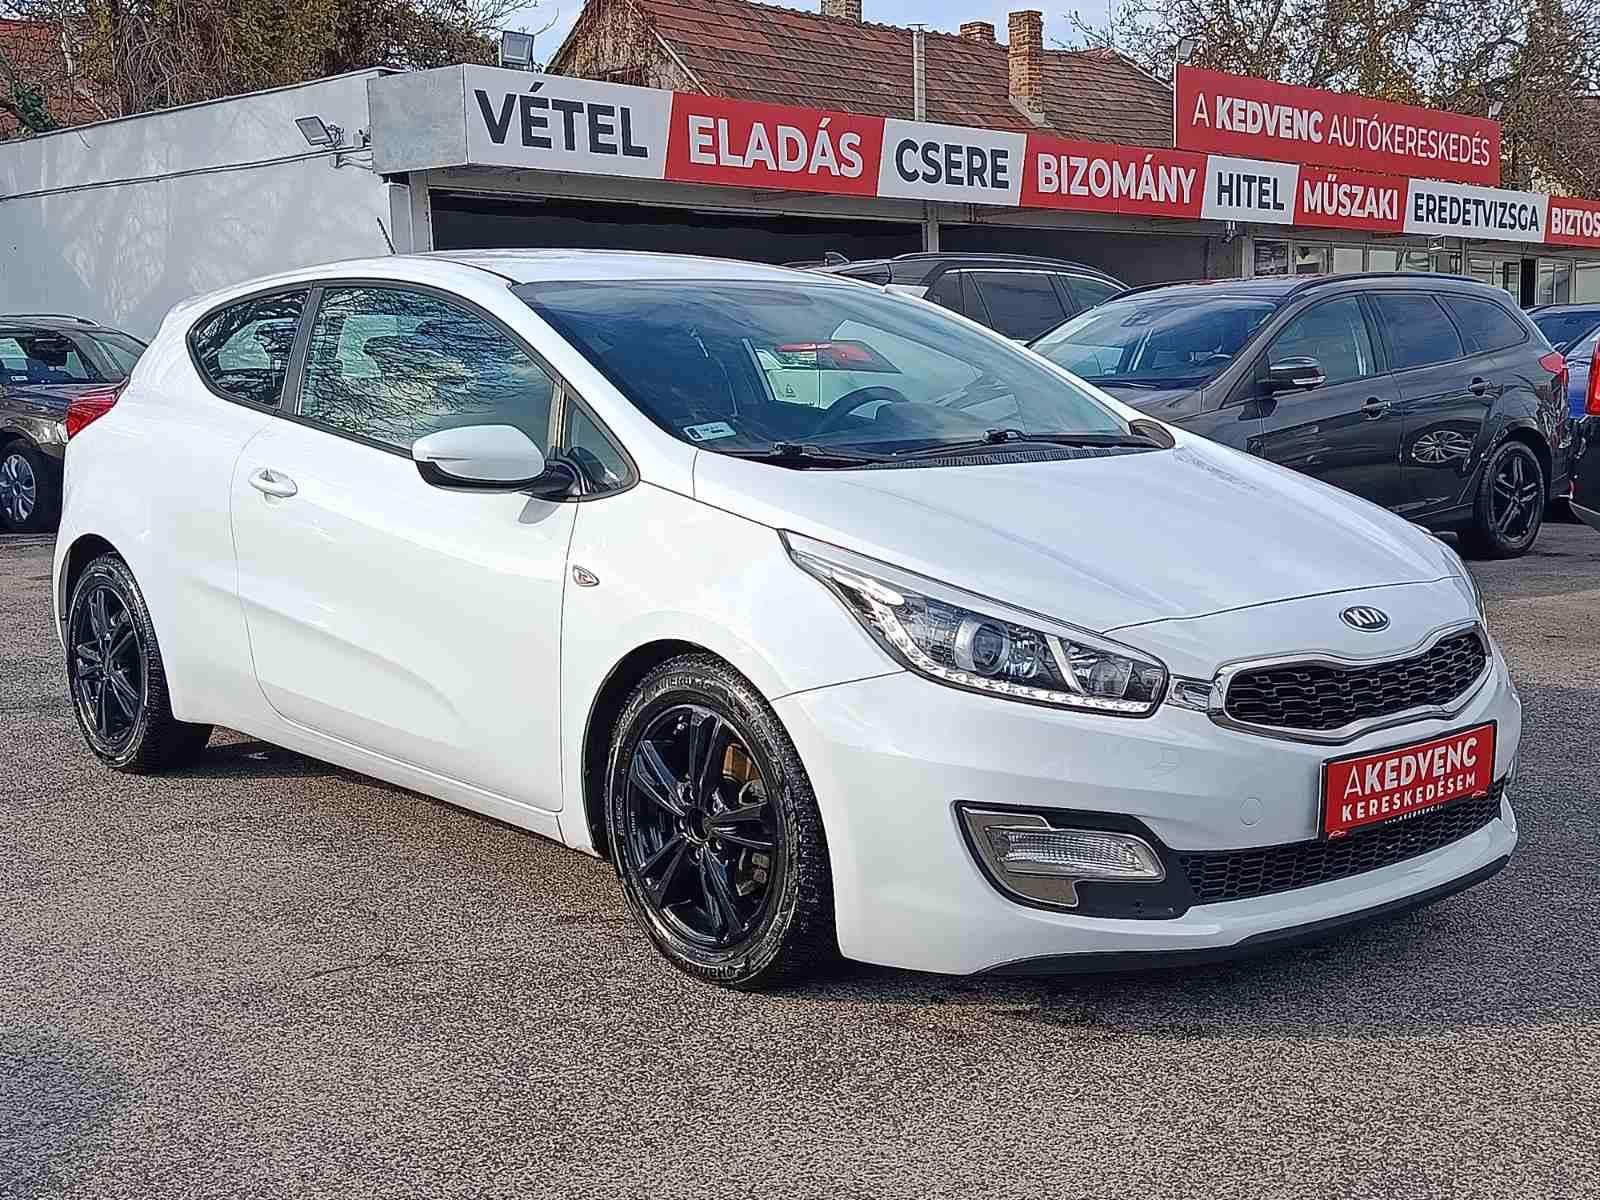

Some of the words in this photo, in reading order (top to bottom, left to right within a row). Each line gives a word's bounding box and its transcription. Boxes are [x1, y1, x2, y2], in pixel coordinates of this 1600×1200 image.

[472, 82, 648, 160] VÉTEL
[687, 114, 864, 178] ELADÁS
[1192, 92, 1210, 127] A
[1216, 96, 1323, 144] KEDVENC
[1328, 115, 1490, 166] AUTÓKERESKEDÉS
[895, 138, 1009, 190] CSERE
[1037, 154, 1196, 204] BIZOMÁNY
[1217, 171, 1285, 212] HITEL
[1303, 174, 1398, 221] MŰSZAKI
[1414, 192, 1540, 232] EREDETVIZSGA
[1551, 206, 1600, 238] BIZTOS
[1345, 607, 1387, 626] KIA
[1342, 771, 1476, 822] KERESKEDÉSEM
